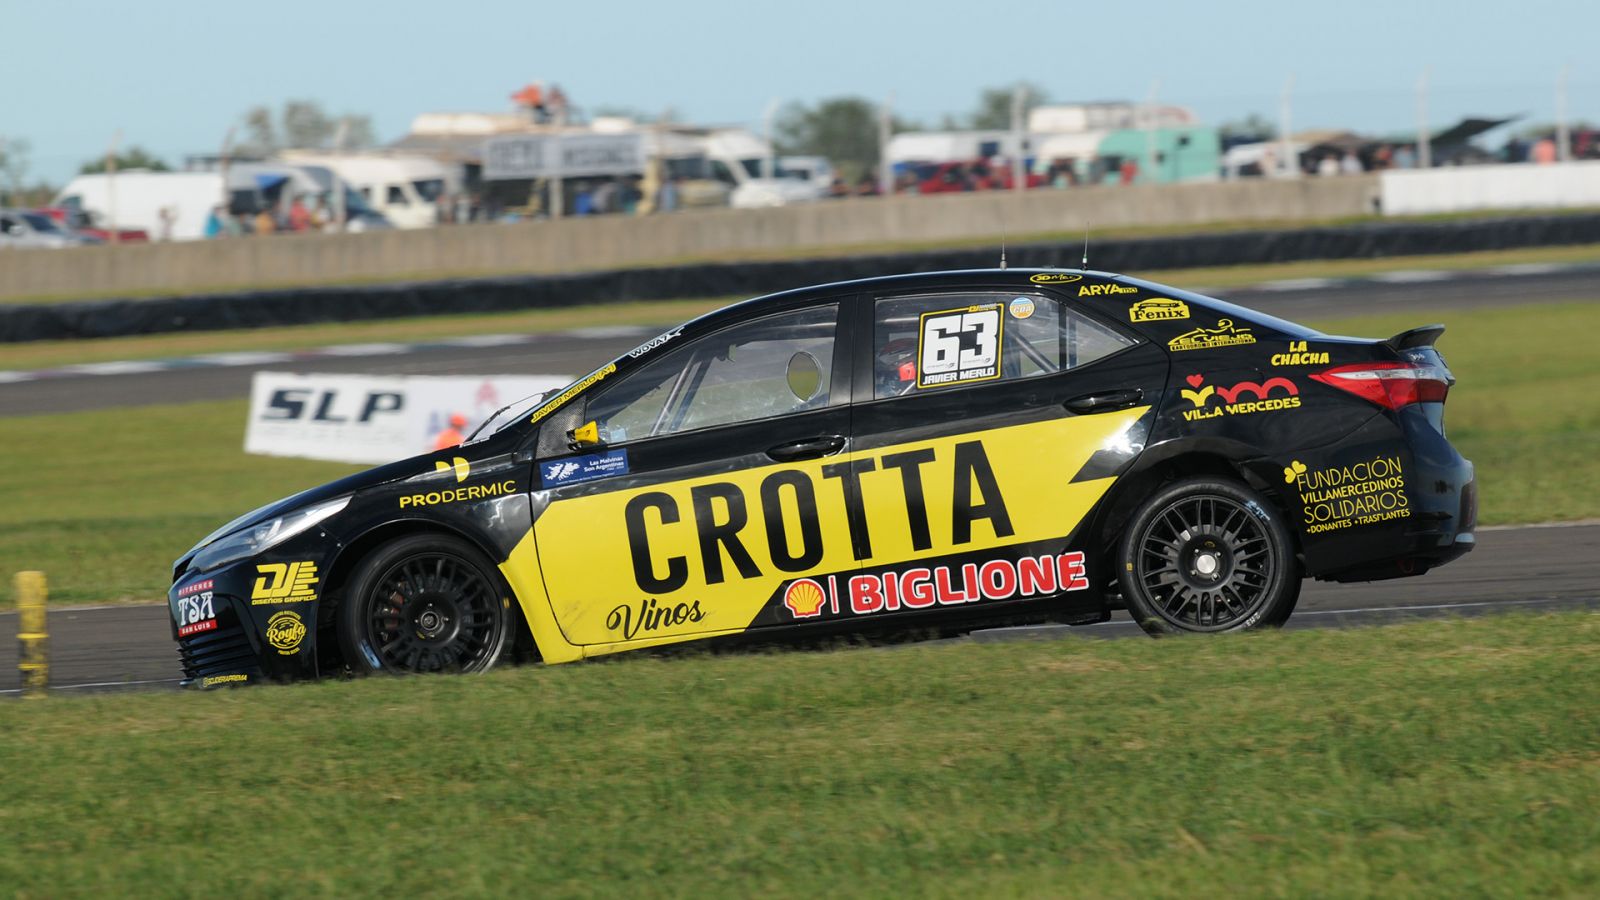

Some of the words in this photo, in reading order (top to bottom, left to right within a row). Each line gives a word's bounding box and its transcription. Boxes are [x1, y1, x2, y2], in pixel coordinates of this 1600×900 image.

[1133, 308, 1186, 321] Fenix
[923, 310, 999, 375] 63
[1289, 340, 1308, 353] LA
[1271, 352, 1330, 366] CHACHA
[923, 372, 958, 386] JAVIER
[959, 367, 996, 381] MERLO
[262, 387, 409, 423] SLP
[532, 396, 565, 422] JAVIER
[1182, 406, 1225, 421] VILLA
[1225, 397, 1302, 415] MERCEDES
[600, 456, 624, 465] Malvinas
[1297, 456, 1402, 491] FUNDACIÓN
[399, 480, 517, 509] PRODERMIC
[1301, 475, 1405, 504] VILLAMERCEDINOS
[624, 439, 1017, 596] CROTTA
[1304, 490, 1408, 524] SOLIDARIOS
[848, 551, 1089, 615] BIGLIONE
[178, 591, 216, 626] TSA
[606, 598, 707, 640] Vinos
[182, 626, 194, 635] SAN
[194, 621, 211, 632] LUIS
[267, 622, 307, 644] Royfa
